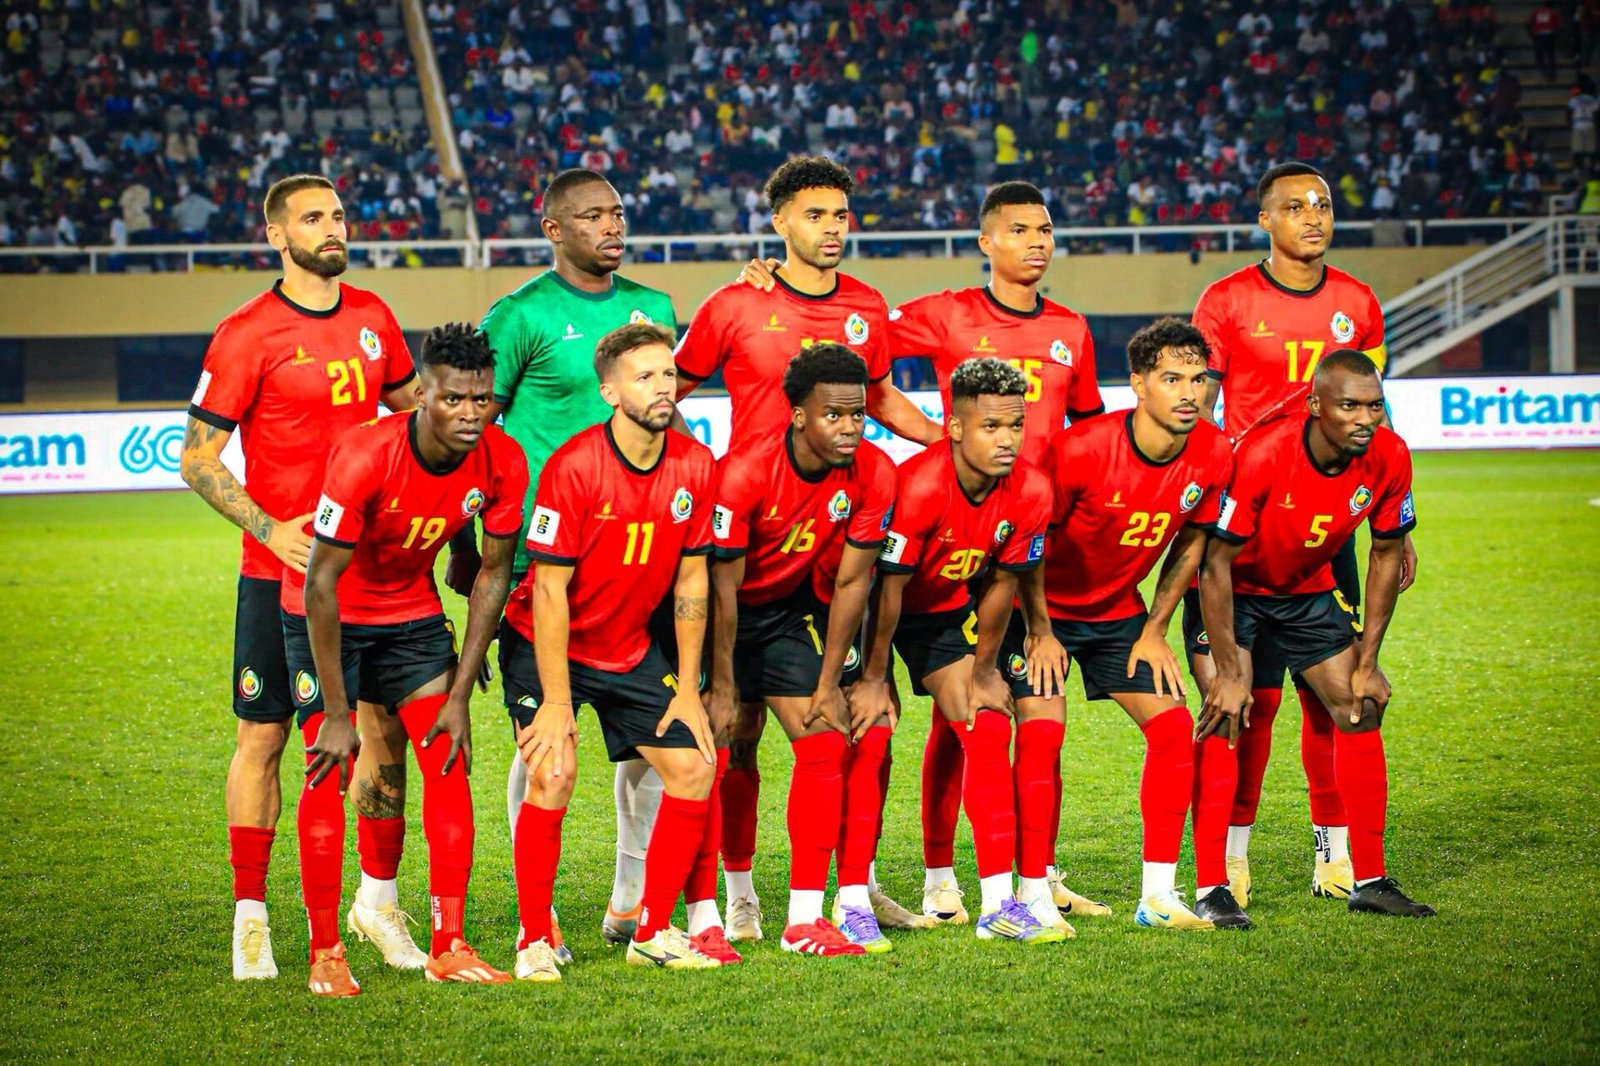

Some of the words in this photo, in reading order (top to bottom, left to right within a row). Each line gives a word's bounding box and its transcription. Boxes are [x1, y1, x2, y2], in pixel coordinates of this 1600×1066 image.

[1284, 340, 1325, 383] 17
[327, 357, 367, 406] 21
[1441, 386, 1600, 425] Britam
[402, 516, 447, 549] 19
[622, 521, 654, 565] 11
[780, 518, 816, 554] 16
[1119, 511, 1171, 547] 23
[1304, 515, 1333, 547] 5
[939, 548, 985, 580] 20
